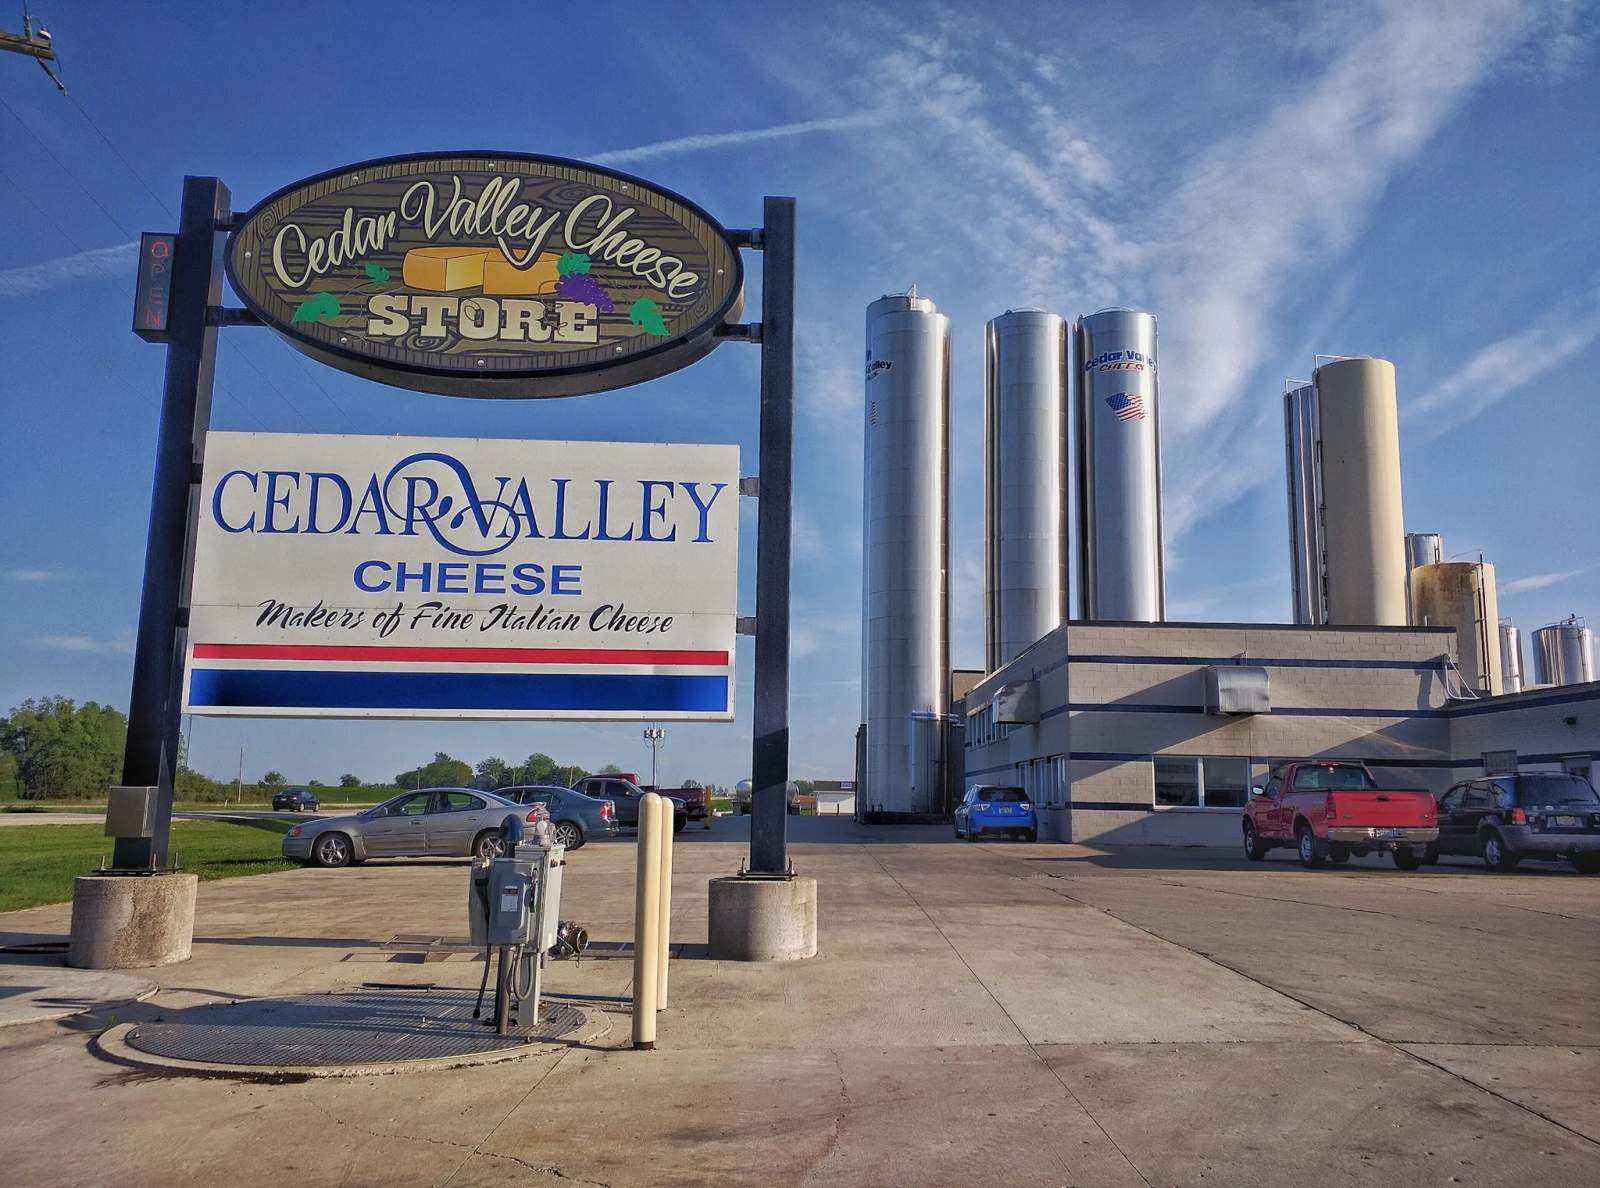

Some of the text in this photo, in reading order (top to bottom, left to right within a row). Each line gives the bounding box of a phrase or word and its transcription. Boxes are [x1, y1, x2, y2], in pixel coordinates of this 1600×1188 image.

[273, 175, 699, 298] Cedar Valley Cheese
[144, 239, 169, 328] OPEN
[368, 295, 598, 343] STORE
[1100, 362, 1145, 371] CHEES
[383, 452, 729, 544] VALLEY
[353, 560, 583, 596] CHEESE
[256, 599, 674, 638] Makers of Fine Italian Cheese
